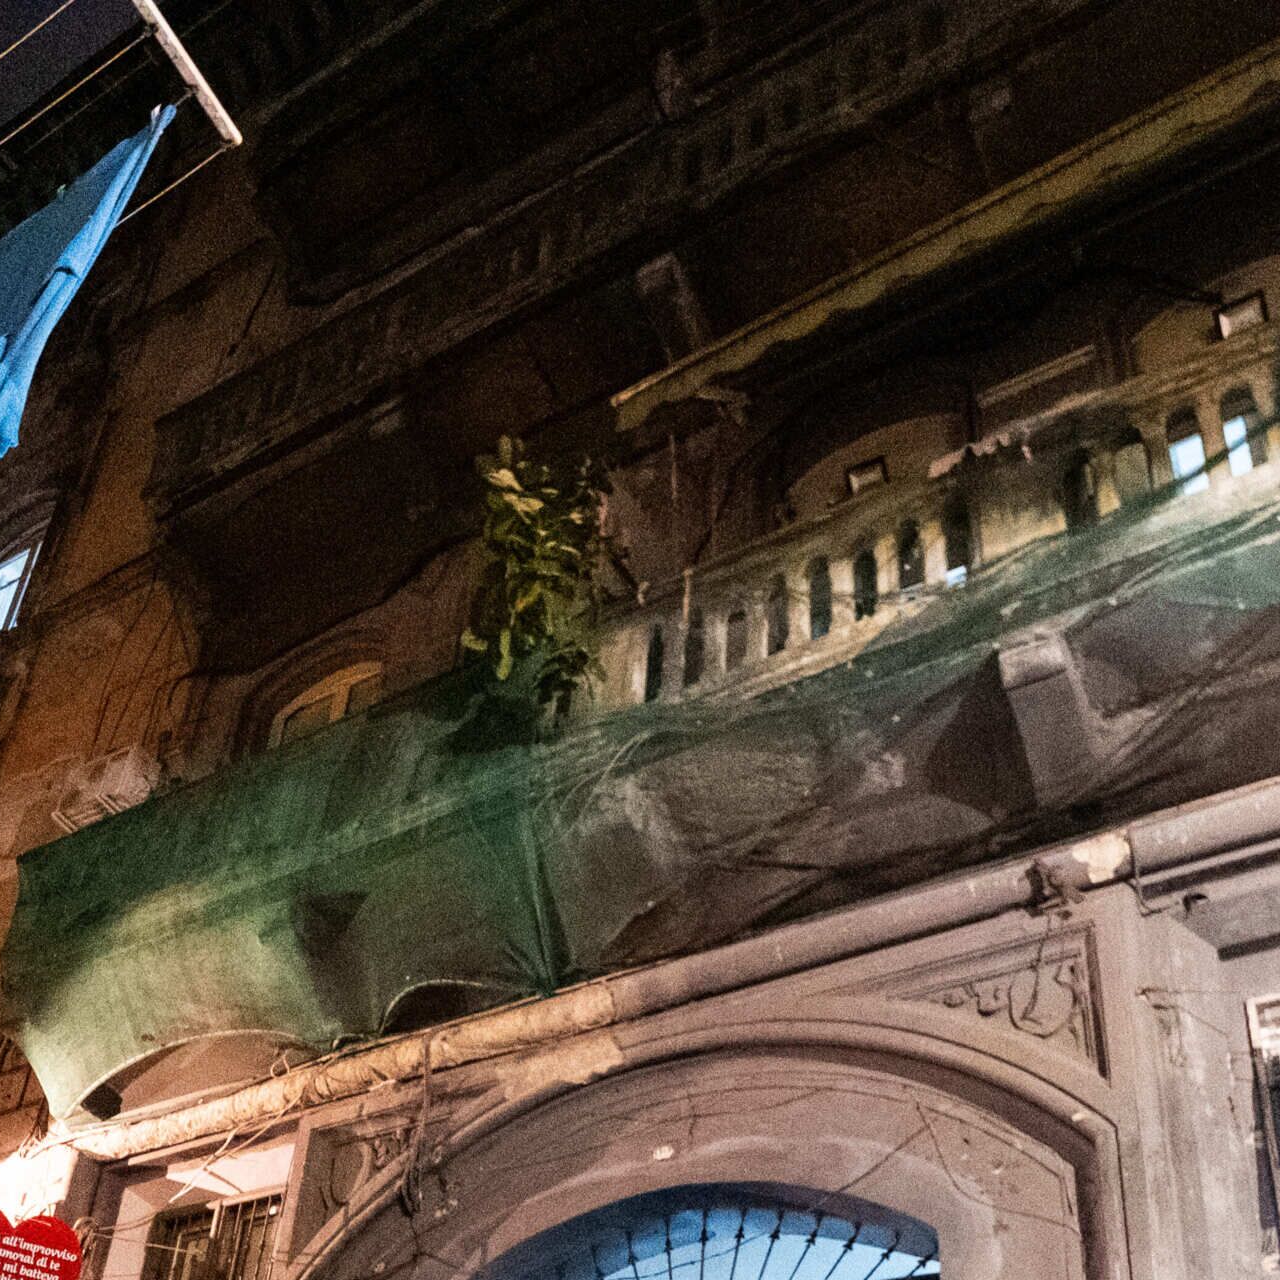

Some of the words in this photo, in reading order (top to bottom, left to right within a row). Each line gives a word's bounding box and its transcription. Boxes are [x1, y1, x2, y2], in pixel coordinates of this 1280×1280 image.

[2, 1235, 78, 1262] all'improvviso
[2, 1262, 18, 1274] mi
[36, 1256, 48, 1269] di
[49, 1260, 61, 1271] te
